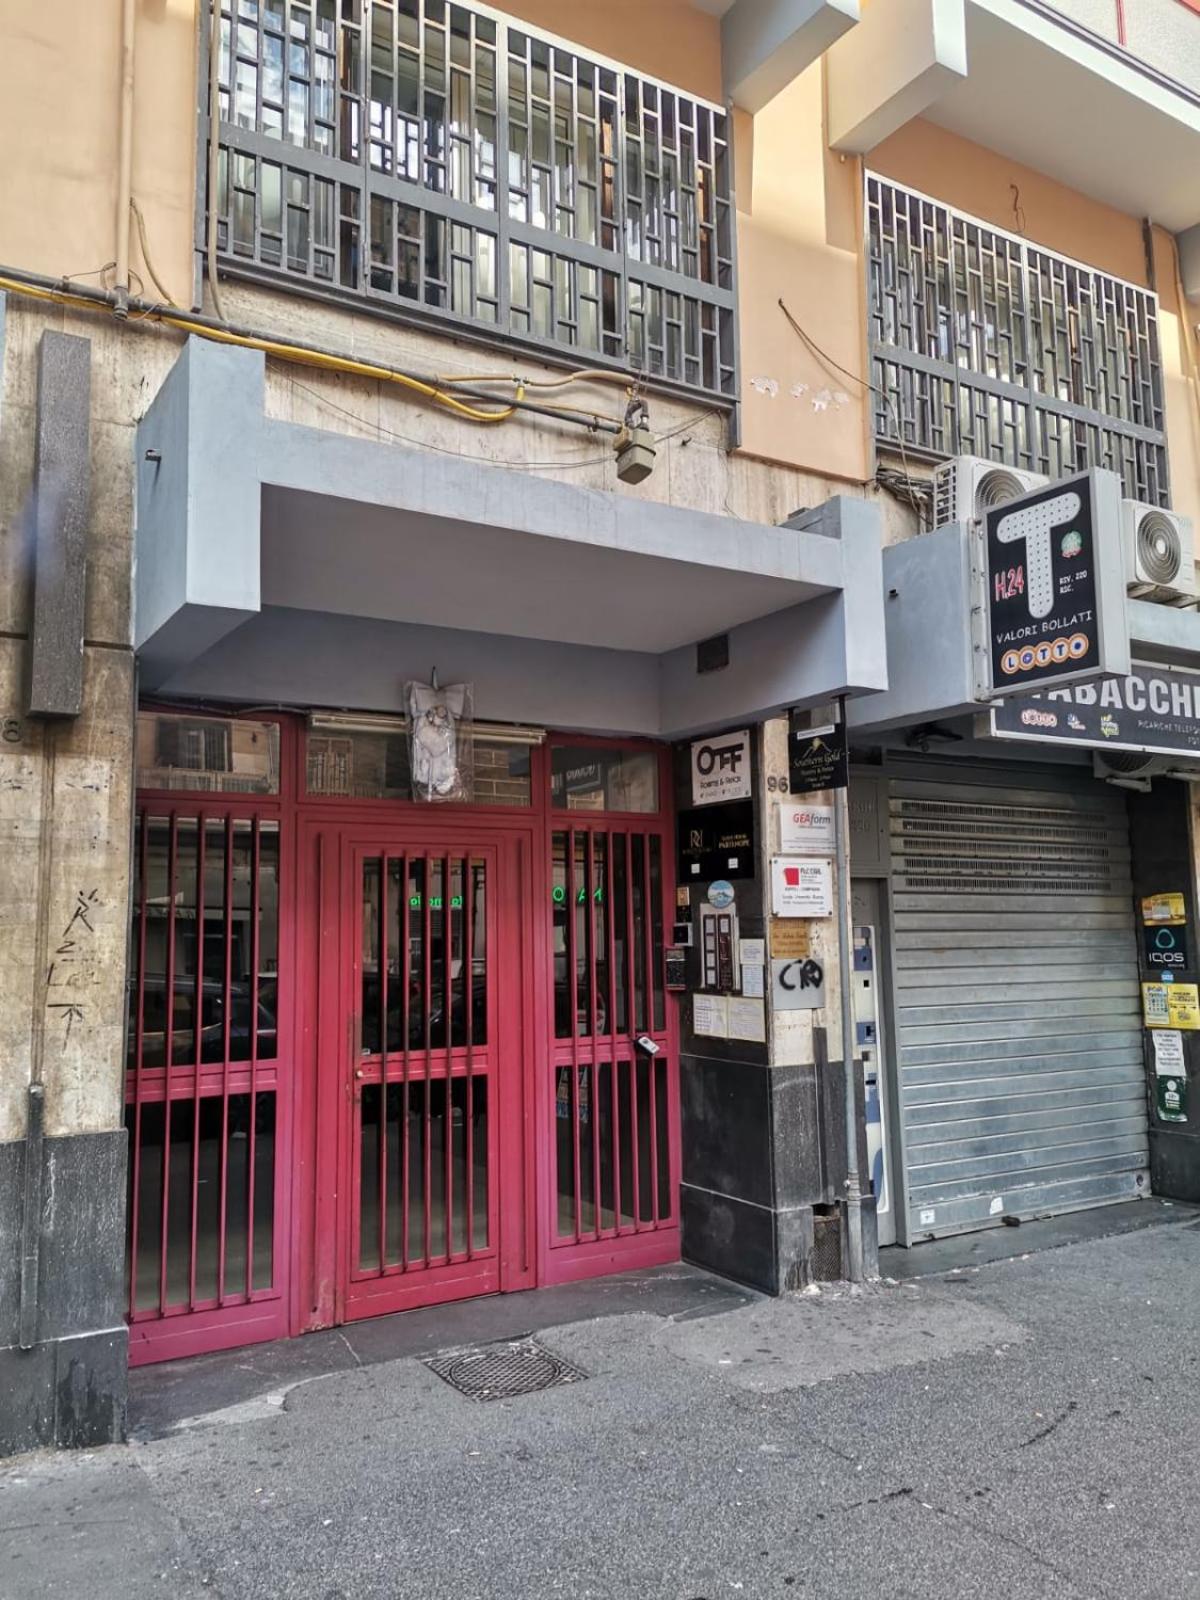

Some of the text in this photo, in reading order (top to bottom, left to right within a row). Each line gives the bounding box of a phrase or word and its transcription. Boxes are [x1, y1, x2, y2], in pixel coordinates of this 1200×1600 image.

[997, 610, 1093, 644] VALORI BOLLATI
[1003, 635, 1087, 673] LOTTO
[697, 743, 744, 775] OFF
[767, 776, 789, 793] 96
[1149, 952, 1184, 965] IQOS
